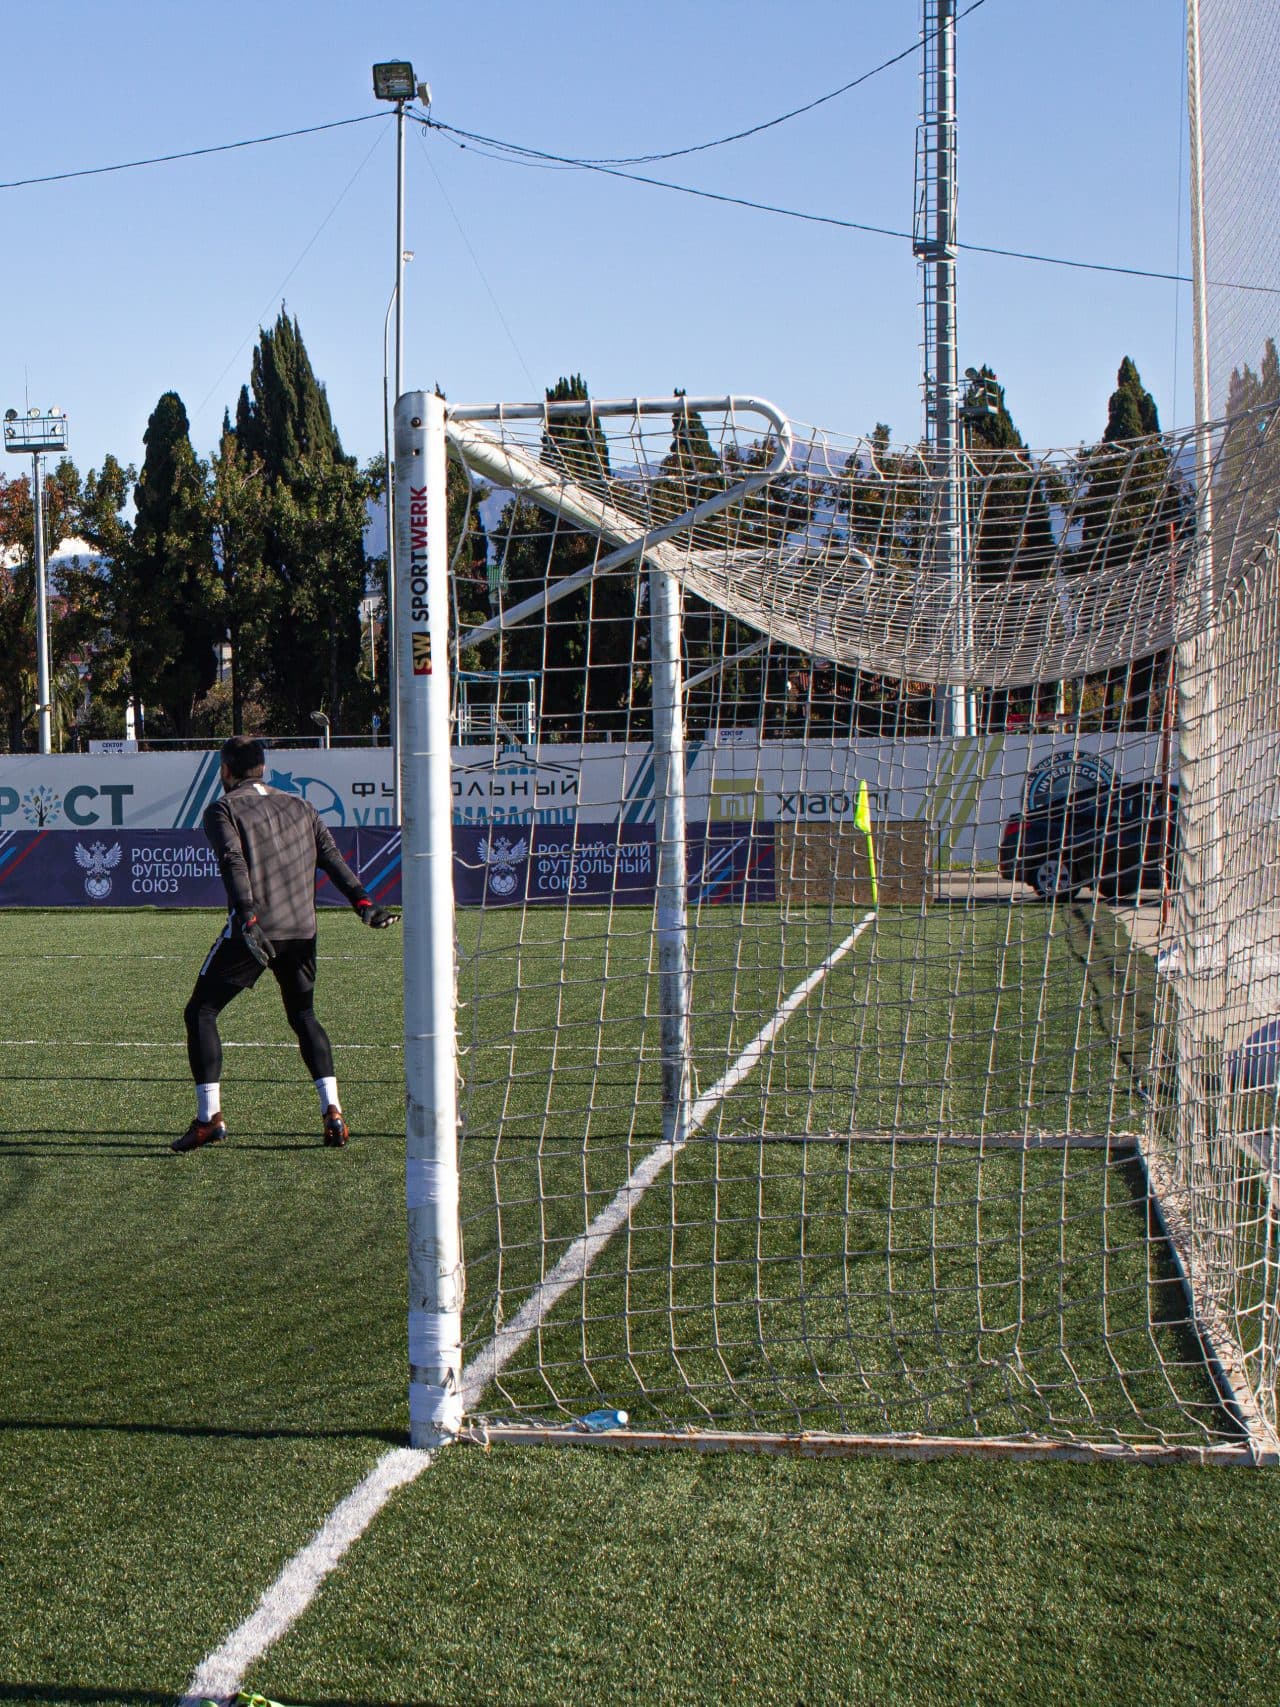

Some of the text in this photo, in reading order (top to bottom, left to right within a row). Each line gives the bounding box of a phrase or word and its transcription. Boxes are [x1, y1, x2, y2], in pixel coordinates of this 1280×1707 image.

[410, 486, 429, 621] SPORTWERK
[131, 846, 218, 862] РОССИЙСК
[538, 841, 651, 858] РОССИЙСКИЙ
[538, 857, 651, 874] ФУТБОЛЬНЫЙ
[131, 879, 179, 893] СОЮЗ
[538, 875, 588, 890] СОЮЗ
